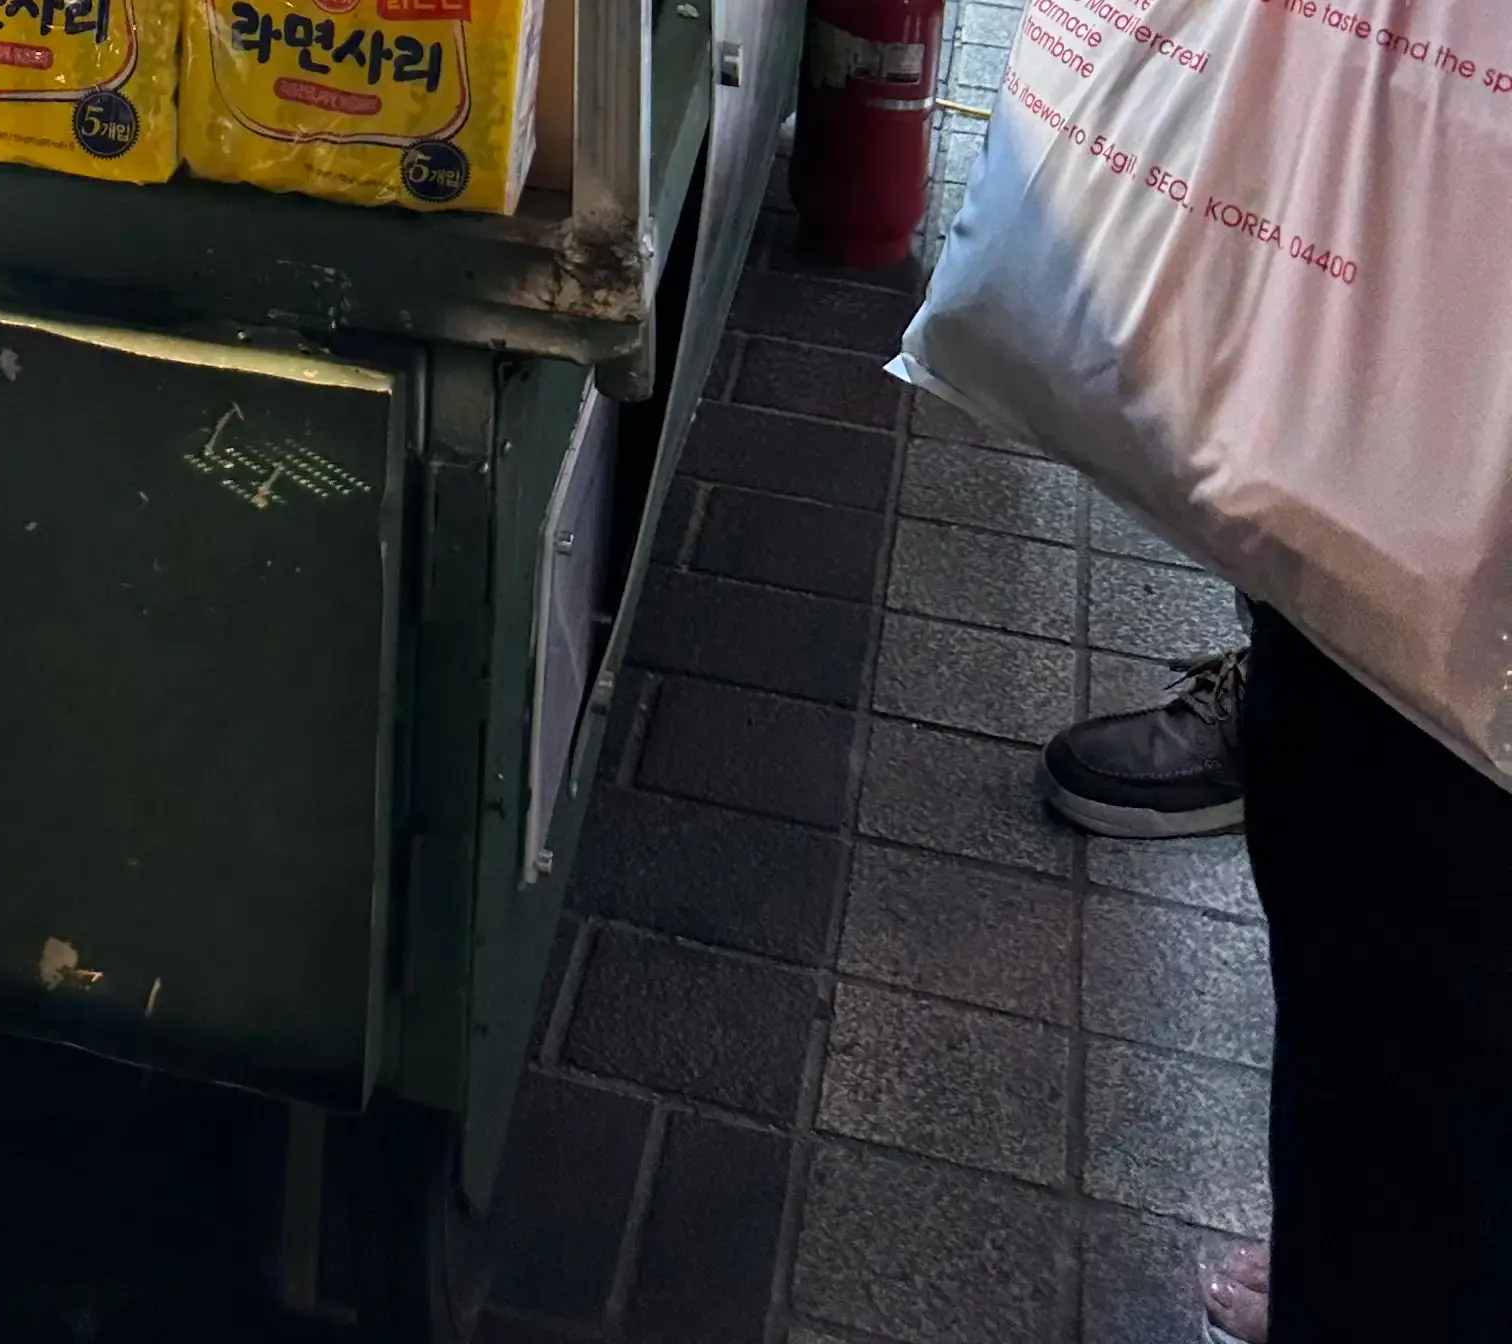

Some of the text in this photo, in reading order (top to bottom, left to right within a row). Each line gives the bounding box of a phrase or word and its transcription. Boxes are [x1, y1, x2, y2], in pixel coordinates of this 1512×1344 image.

[231, 1, 442, 92] 라면사리
[1132, 17, 1210, 75] ercredi
[1321, 3, 1371, 39] taste
[1376, 27, 1430, 62] and
[1434, 45, 1476, 79] the
[1482, 67, 1512, 94] sp
[81, 106, 131, 143] 5개입
[410, 154, 461, 188] 5개입
[1289, 235, 1358, 285] 04400
